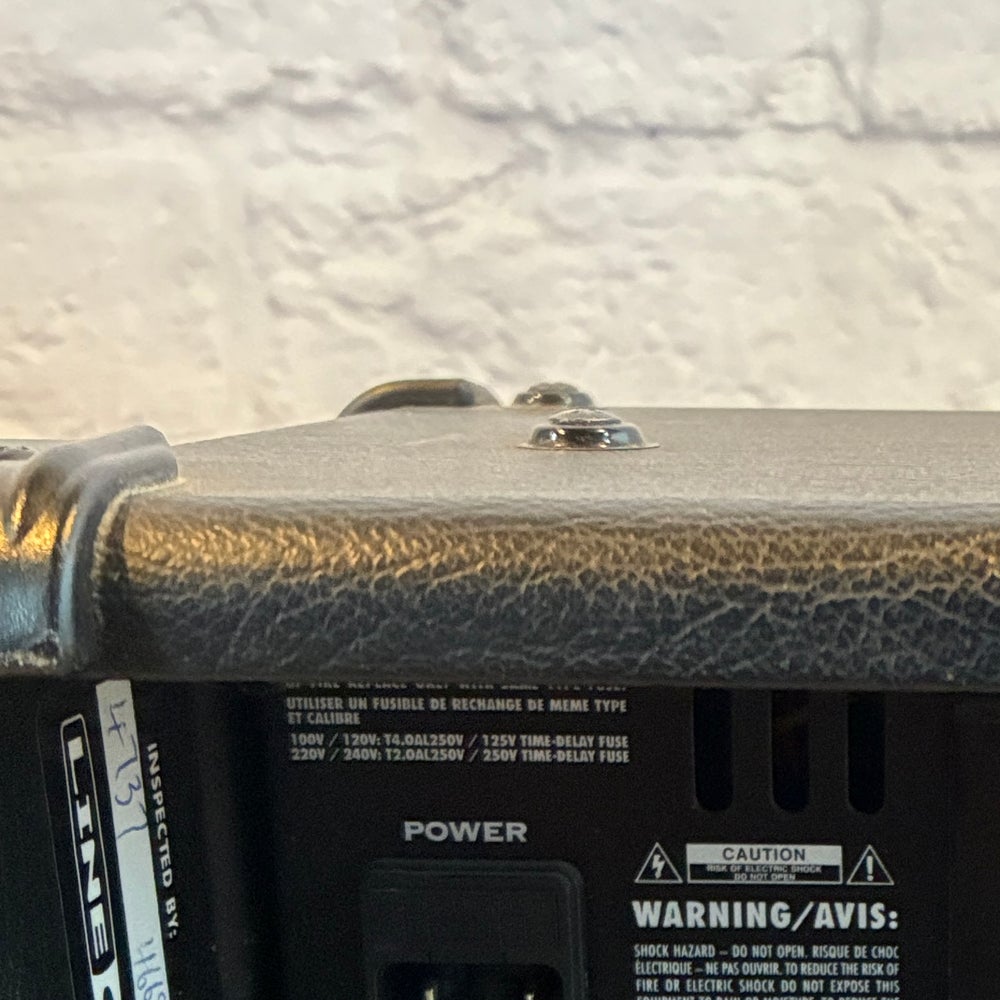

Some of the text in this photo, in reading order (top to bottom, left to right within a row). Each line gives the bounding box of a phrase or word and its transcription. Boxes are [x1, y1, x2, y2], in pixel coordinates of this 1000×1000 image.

[286, 697, 627, 713] UTILISER UN FUSIBLE DE RECHANGE DE MEME TYPE
[288, 712, 360, 725] ET CALIBRE
[290, 732, 324, 747] 100V
[481, 734, 516, 748] 125V
[520, 734, 594, 748] TIME-DELAY
[598, 735, 629, 749] FUSE
[291, 748, 325, 762] 220V
[483, 749, 517, 763] 250V
[521, 749, 595, 763] TIME-DELAY
[599, 749, 630, 763] FUSE
[403, 821, 528, 842] POWER
[68, 736, 109, 960] LINE
[148, 743, 179, 939] INSPECTED BY:
[722, 847, 806, 862] CAUTION
[706, 864, 727, 872] RISK
[745, 865, 788, 873] ELECTRIC
[791, 865, 822, 873] SHOCK
[734, 873, 796, 881] DO NOT OPEN
[631, 901, 898, 932] WARNING/AVIS:
[634, 945, 669, 958] SHOCK
[673, 945, 716, 959] HAZARD
[732, 945, 748, 959] DO
[751, 945, 772, 959] NOT
[812, 945, 850, 959] RISQUE
[853, 945, 867, 959] DE
[871, 945, 899, 959] CHOC
[705, 961, 718, 975] NE
[721, 961, 739, 976] PAS
[785, 962, 798, 976] TO
[800, 962, 838, 976] REDUCE
[841, 962, 858, 976] THE
[861, 962, 884, 976] RISK
[886, 962, 899, 976] OF
[635, 979, 900, 993] FIRE OR ELECTRIC SHOCK DO NOT EXPOSE THIS
